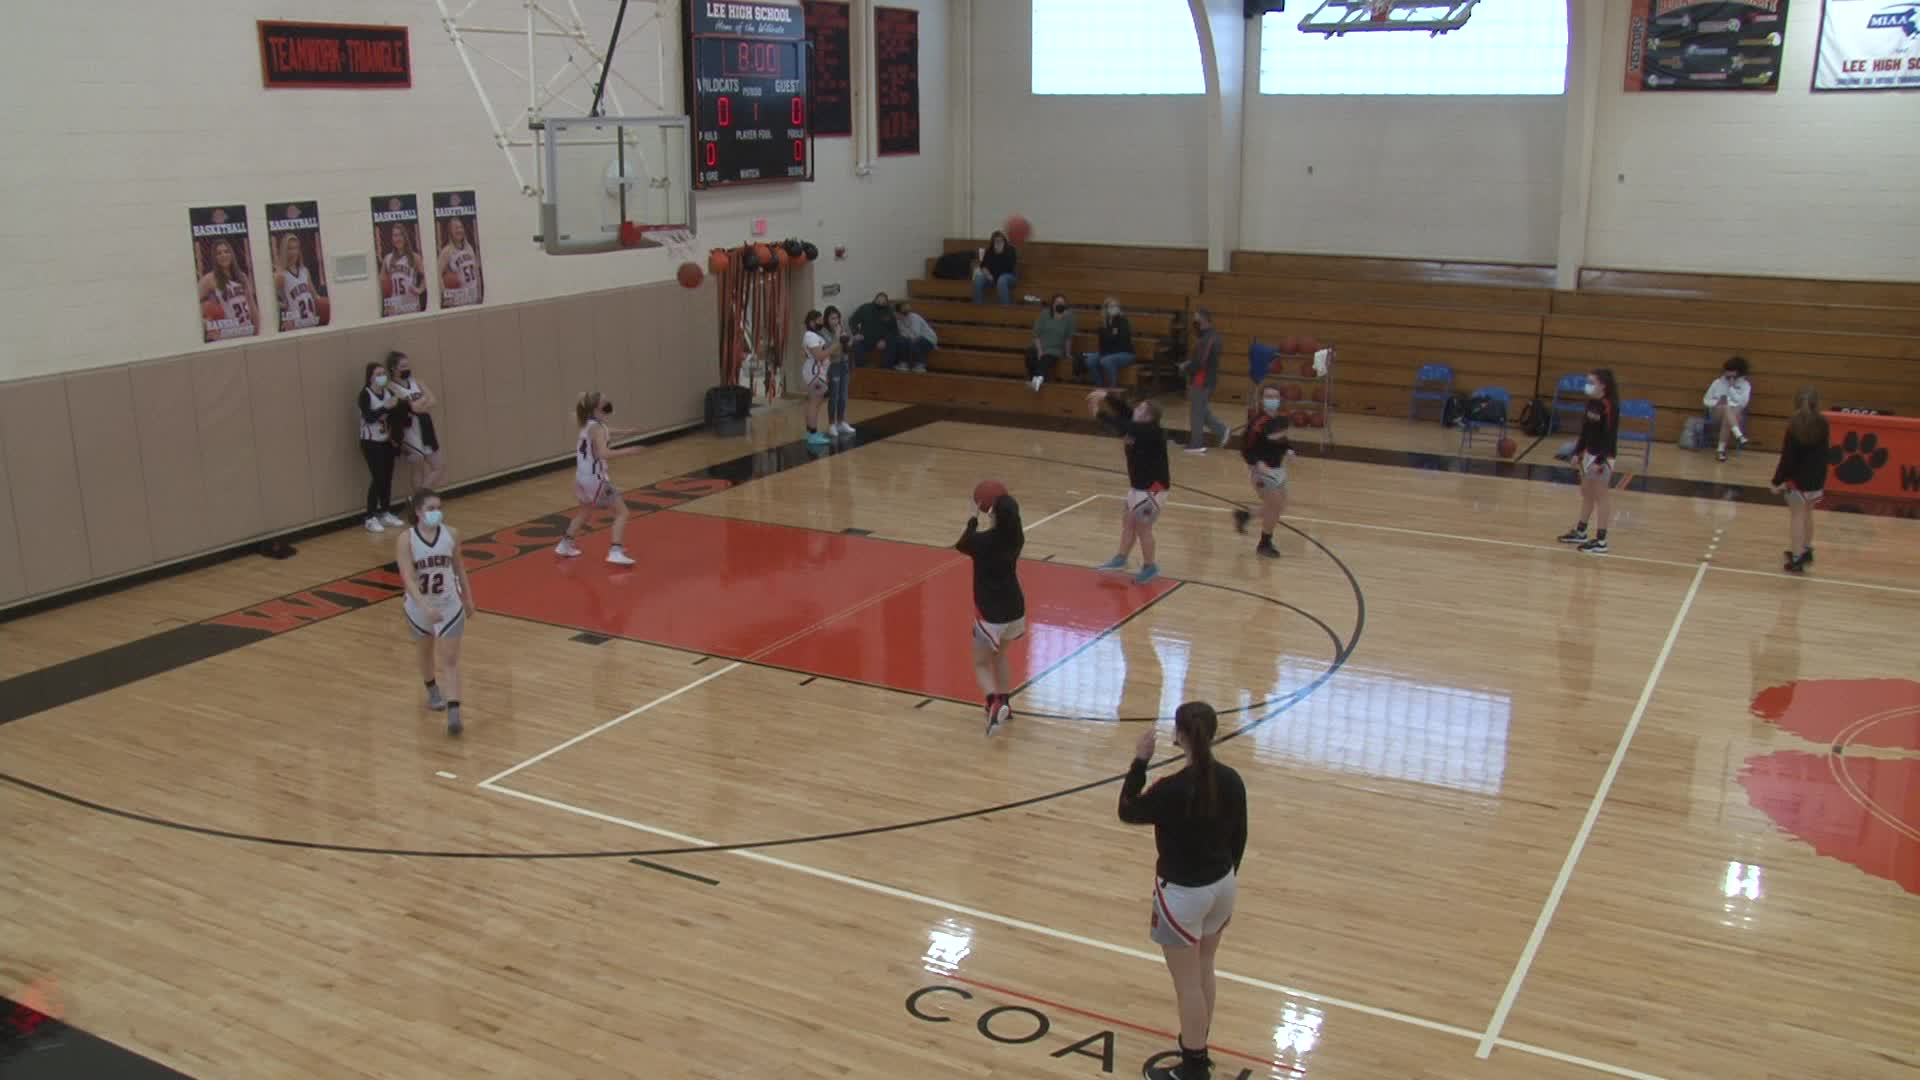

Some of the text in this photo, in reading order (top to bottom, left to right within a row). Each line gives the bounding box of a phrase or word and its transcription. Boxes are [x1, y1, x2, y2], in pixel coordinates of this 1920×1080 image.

[706, 3, 792, 22] LEE HIGH SCHOOL
[1871, 16, 1907, 26] MIAA
[738, 42, 777, 72] 8:00
[1842, 60, 1867, 73] LEE
[1872, 59, 1902, 72] HIGH
[775, 79, 800, 93] GUEST
[718, 96, 729, 126] 0
[792, 96, 803, 124] 0
[707, 143, 716, 166] 0
[795, 140, 802, 161] 0
[193, 222, 247, 236] BASKETBALL
[269, 217, 319, 231] BASKETBALL
[418, 573, 444, 594] 32
